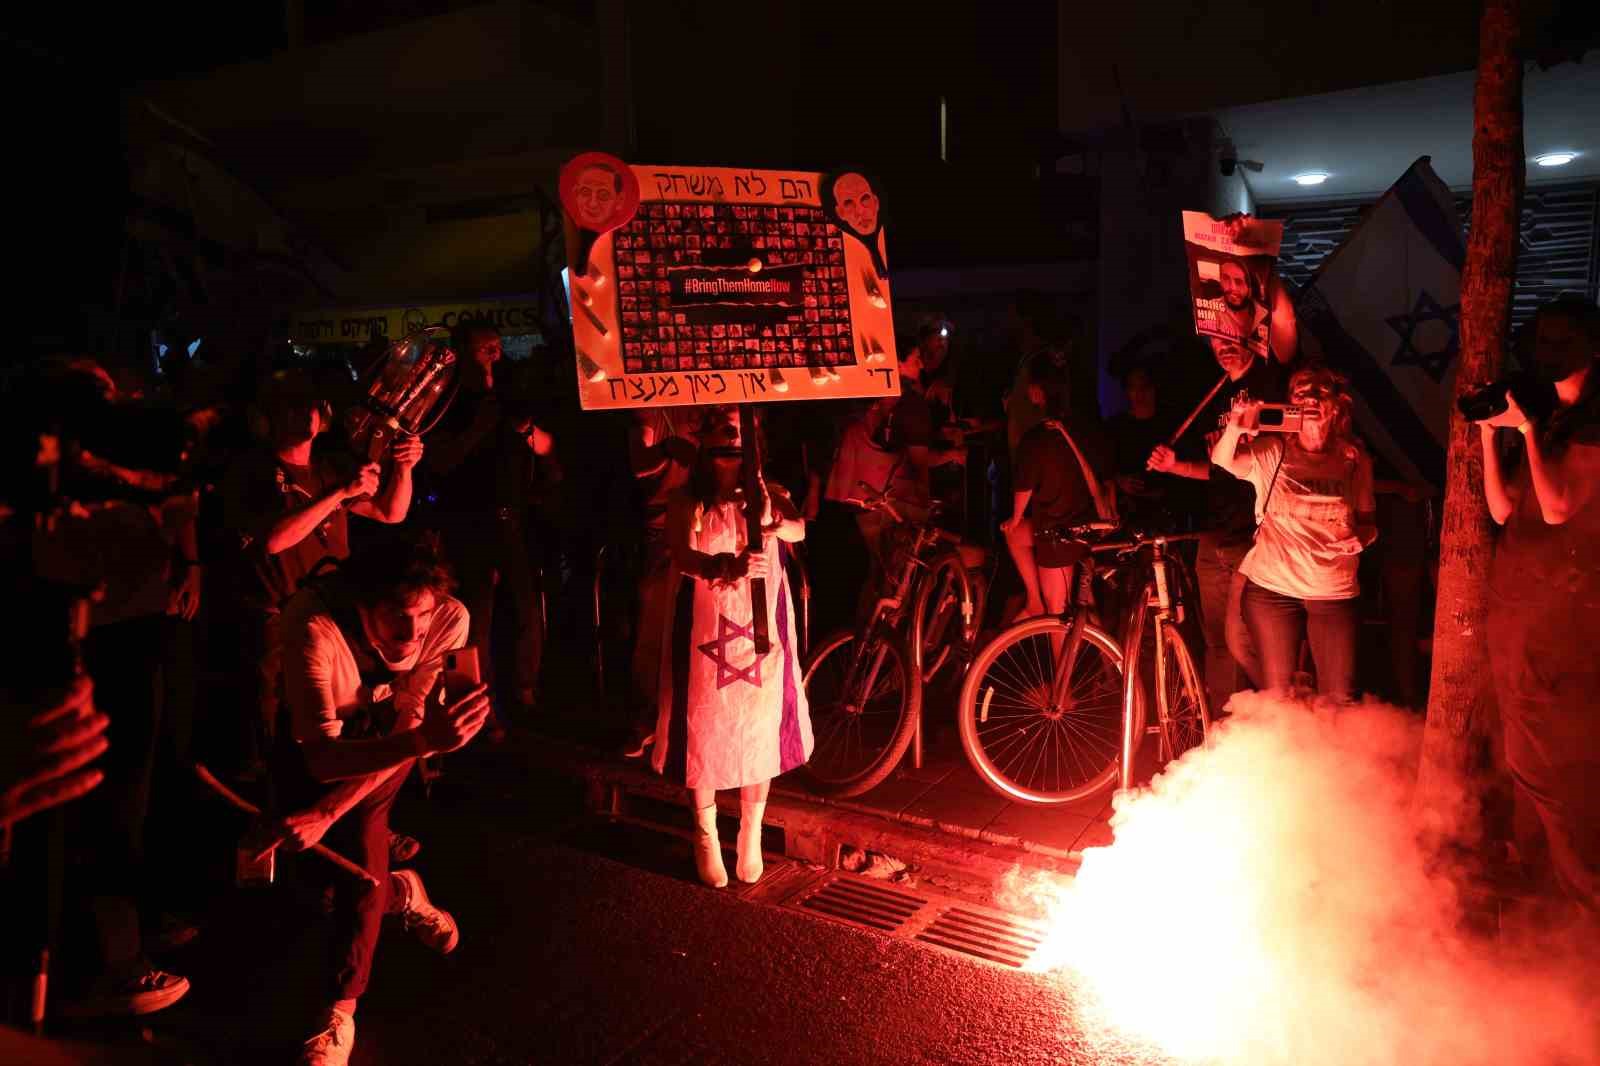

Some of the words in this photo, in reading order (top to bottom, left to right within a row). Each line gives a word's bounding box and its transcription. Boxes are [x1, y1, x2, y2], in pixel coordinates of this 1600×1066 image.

[653, 173, 724, 199] משחק
[735, 172, 767, 197] לא
[781, 178, 813, 199] הם
[683, 278, 791, 298] #BringThemHomeNow
[443, 307, 536, 329] COMICS
[607, 375, 680, 402] מנצח
[684, 374, 728, 402] כאן
[739, 372, 767, 399] אין
[866, 368, 894, 390] די
